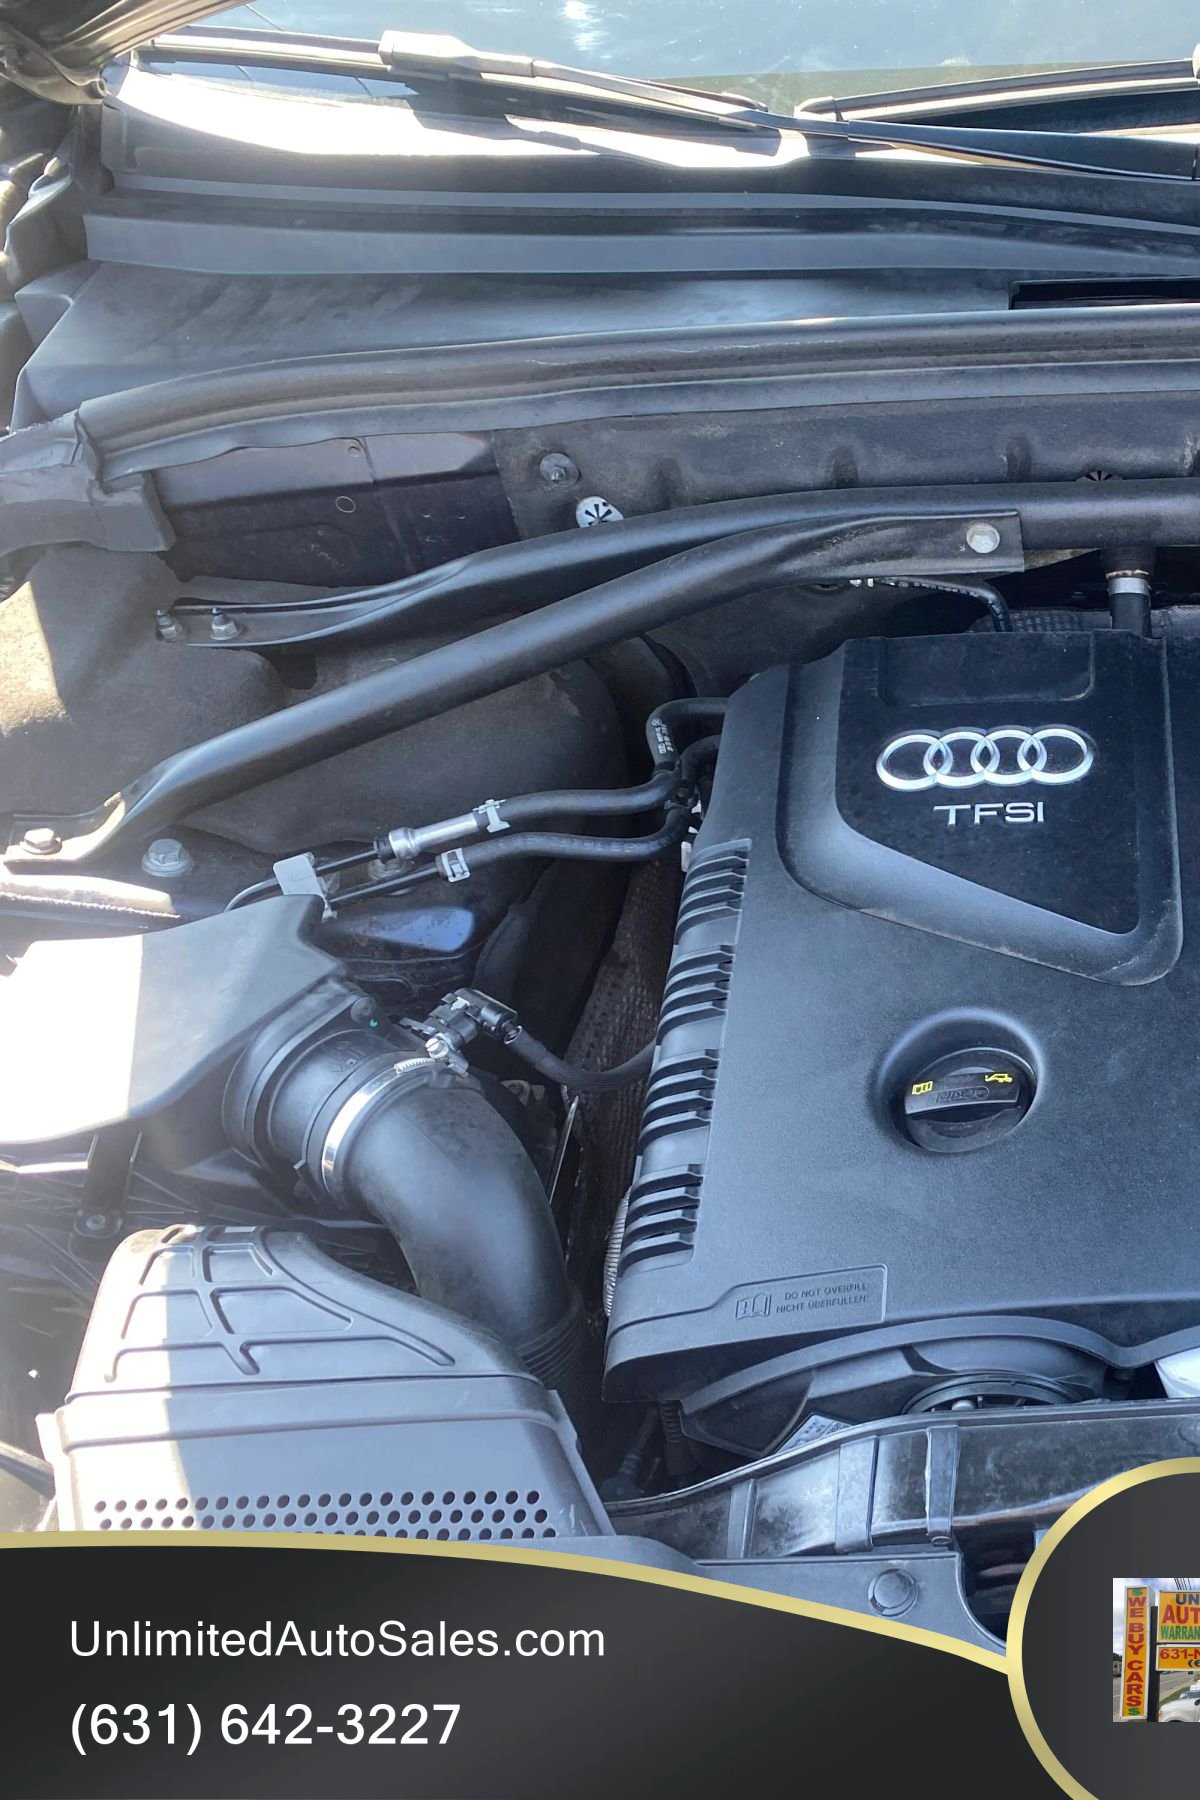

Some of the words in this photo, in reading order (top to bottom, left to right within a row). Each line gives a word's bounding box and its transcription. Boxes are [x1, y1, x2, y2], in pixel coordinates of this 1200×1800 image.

[933, 801, 1045, 825] TFSI
[784, 1292, 798, 1300] DO
[801, 1289, 820, 1298] NOT
[776, 1302, 804, 1313] NICHT
